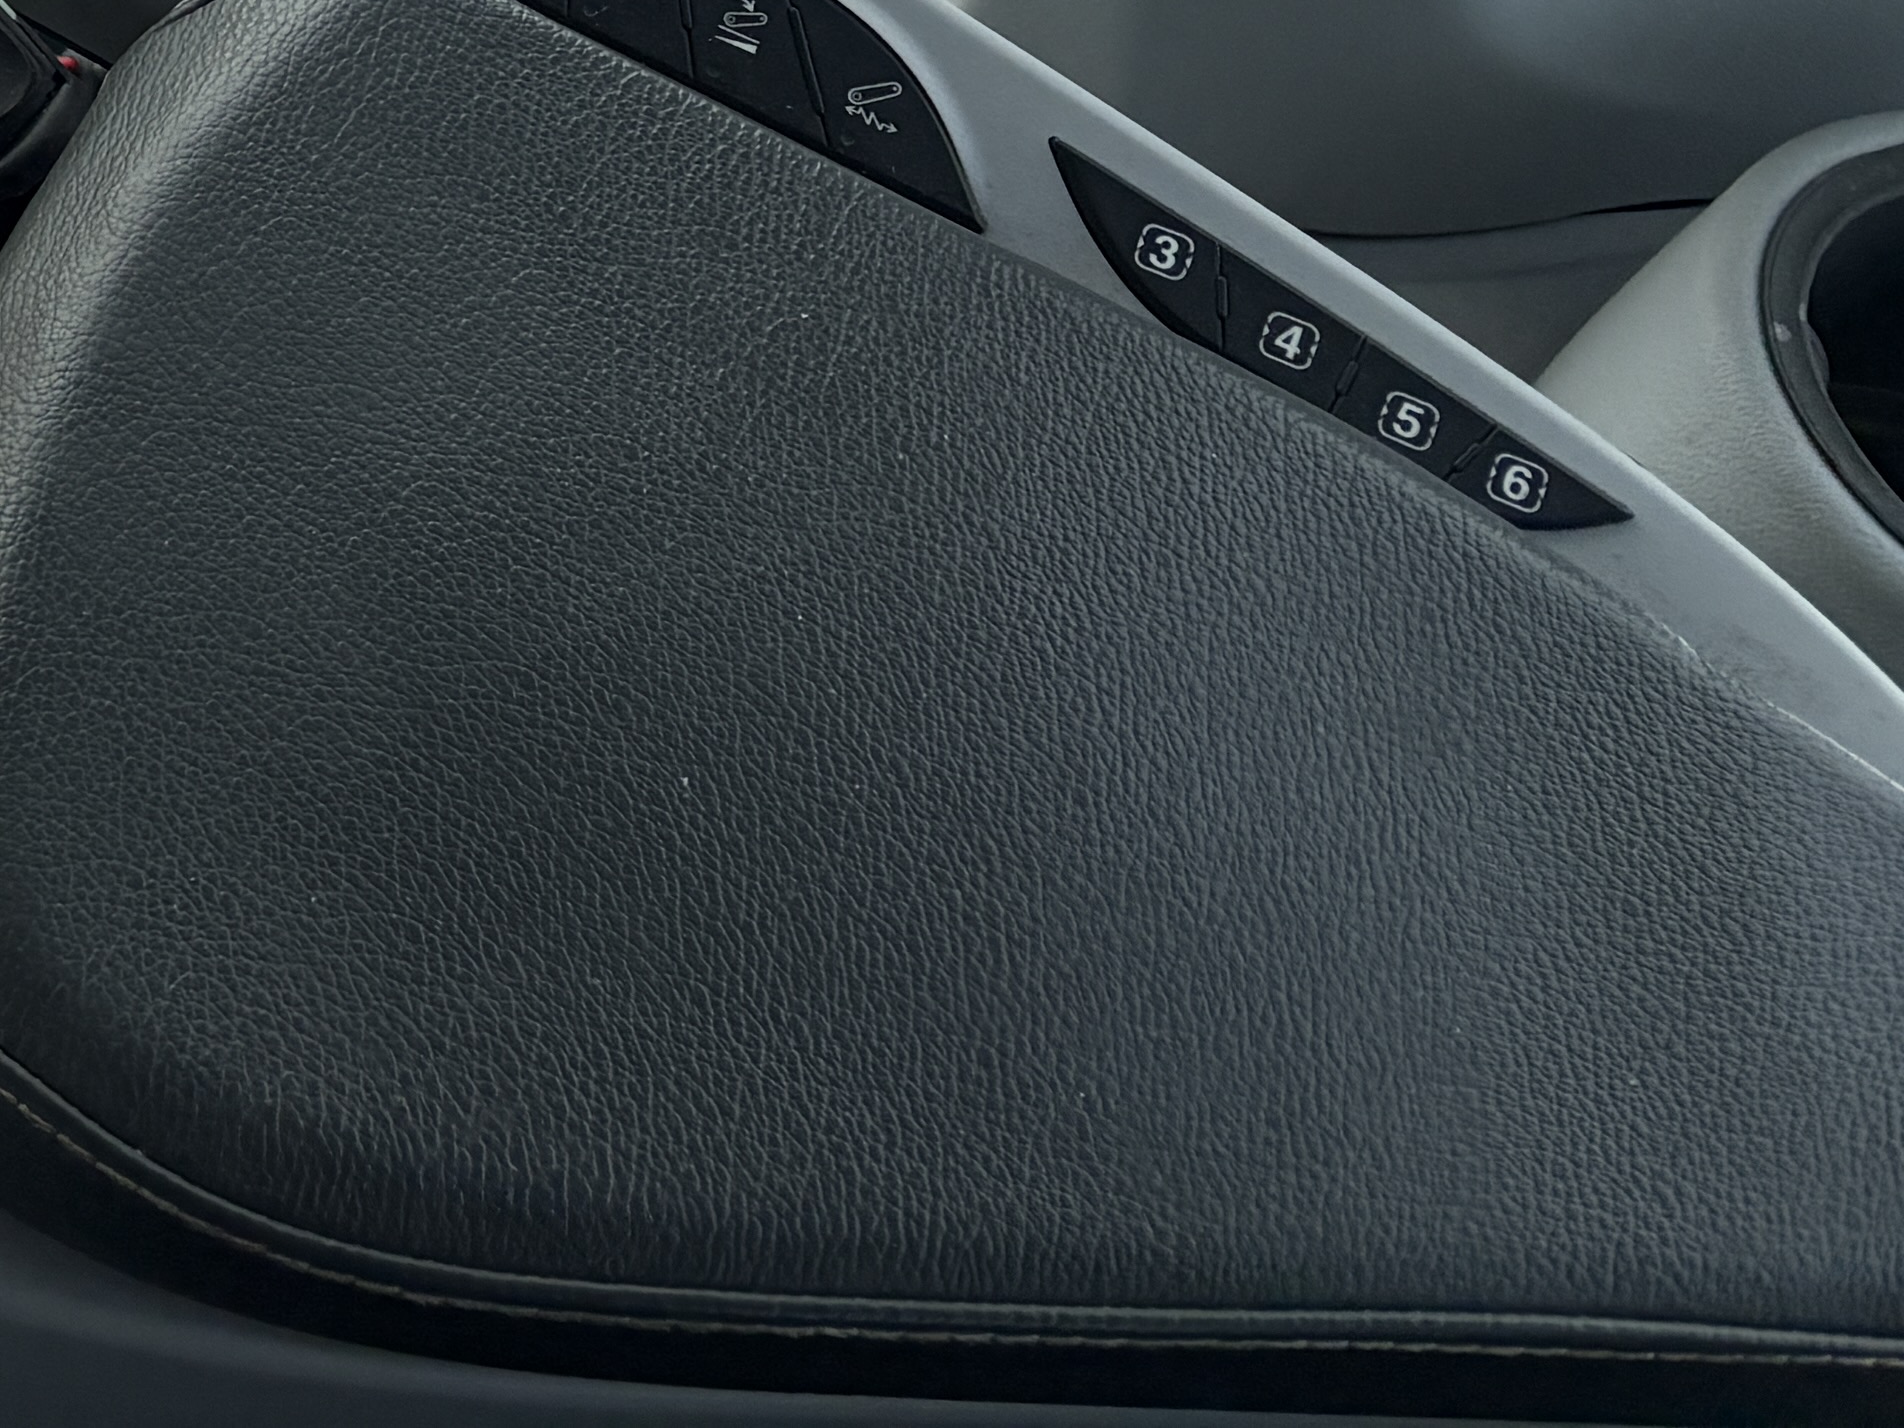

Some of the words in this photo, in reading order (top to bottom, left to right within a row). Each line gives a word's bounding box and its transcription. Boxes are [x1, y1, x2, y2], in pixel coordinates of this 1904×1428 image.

[1148, 235, 1180, 269] 3
[1273, 324, 1306, 359] 4
[1392, 405, 1425, 439] 5
[1502, 465, 1534, 501] 6
